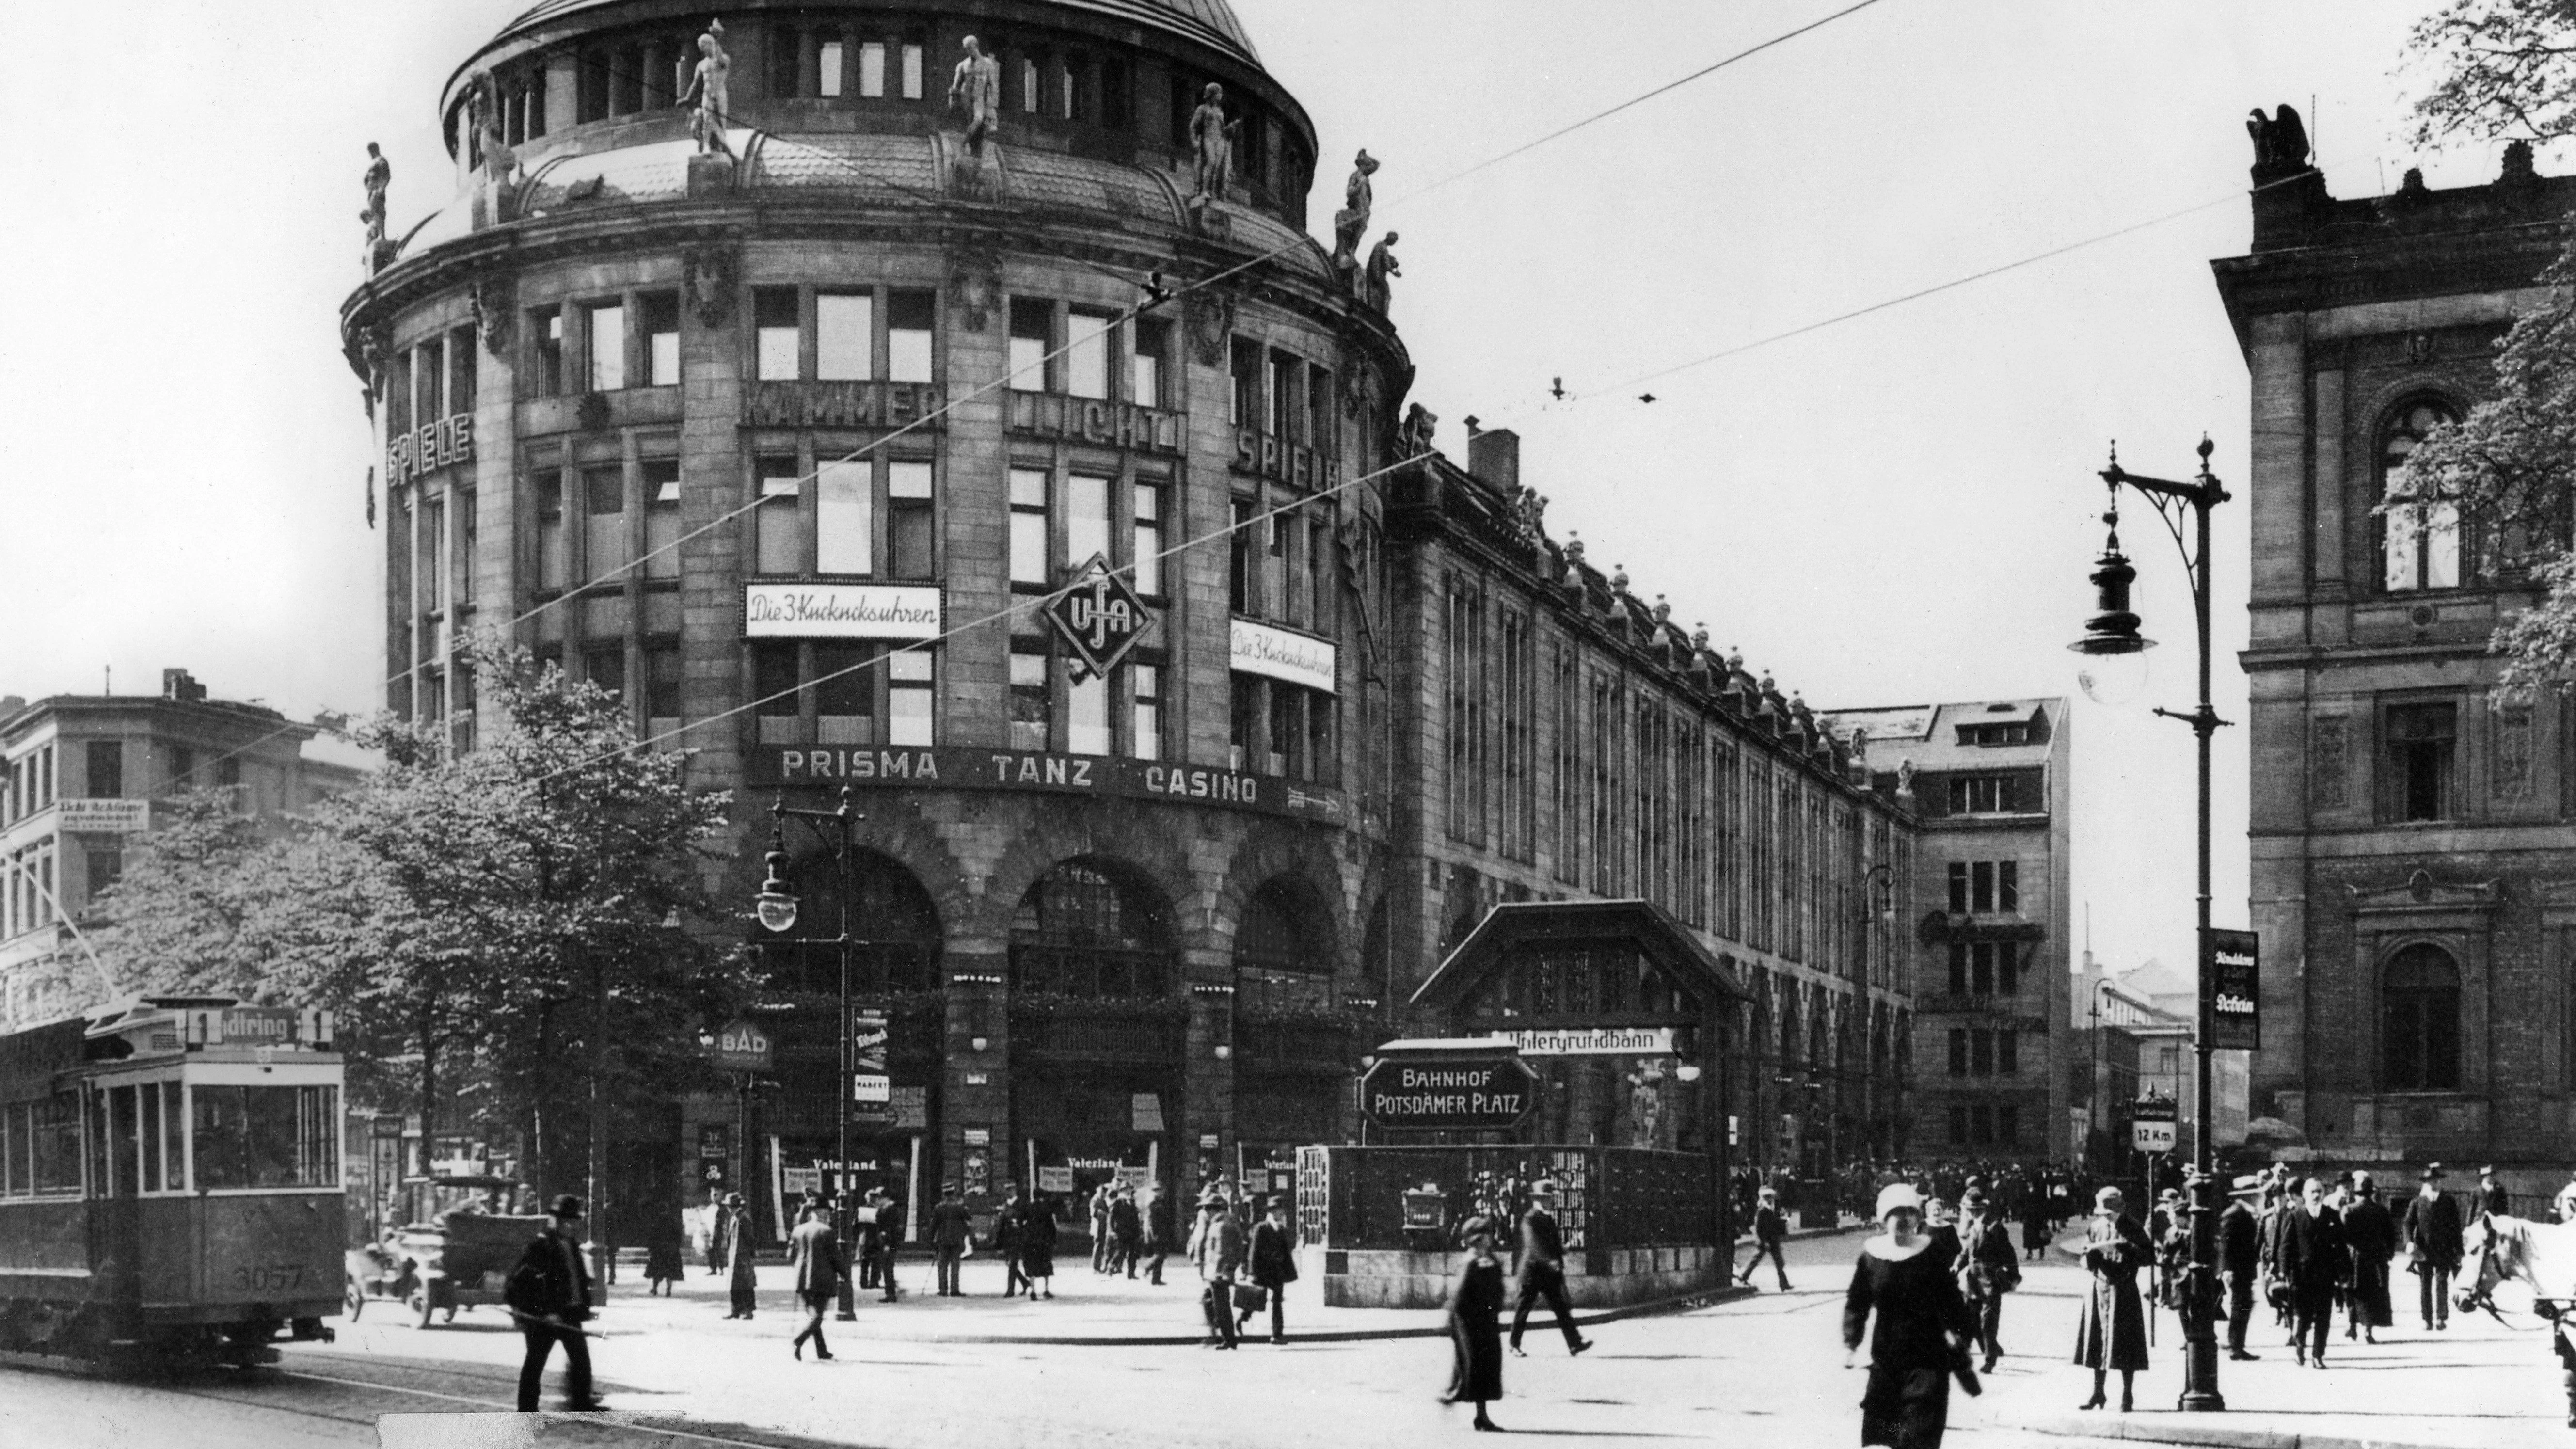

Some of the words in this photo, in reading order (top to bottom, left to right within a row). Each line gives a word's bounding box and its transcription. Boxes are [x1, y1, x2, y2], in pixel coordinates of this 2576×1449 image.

[387, 413, 469, 487] SPIELE
[750, 594, 781, 621] Die
[784, 594, 796, 621] 3
[782, 750, 938, 779] PRISMA
[991, 755, 1092, 786] TANZ
[1146, 766, 1257, 803] CASINO
[722, 1028, 766, 1052] BAD
[1403, 1069, 1492, 1087] BAHNHOF
[1472, 1093, 1520, 1114] PLATZ
[2138, 1130, 2148, 1142] 12
[813, 1159, 876, 1171] Vateland
[233, 1265, 304, 1291] 3057
